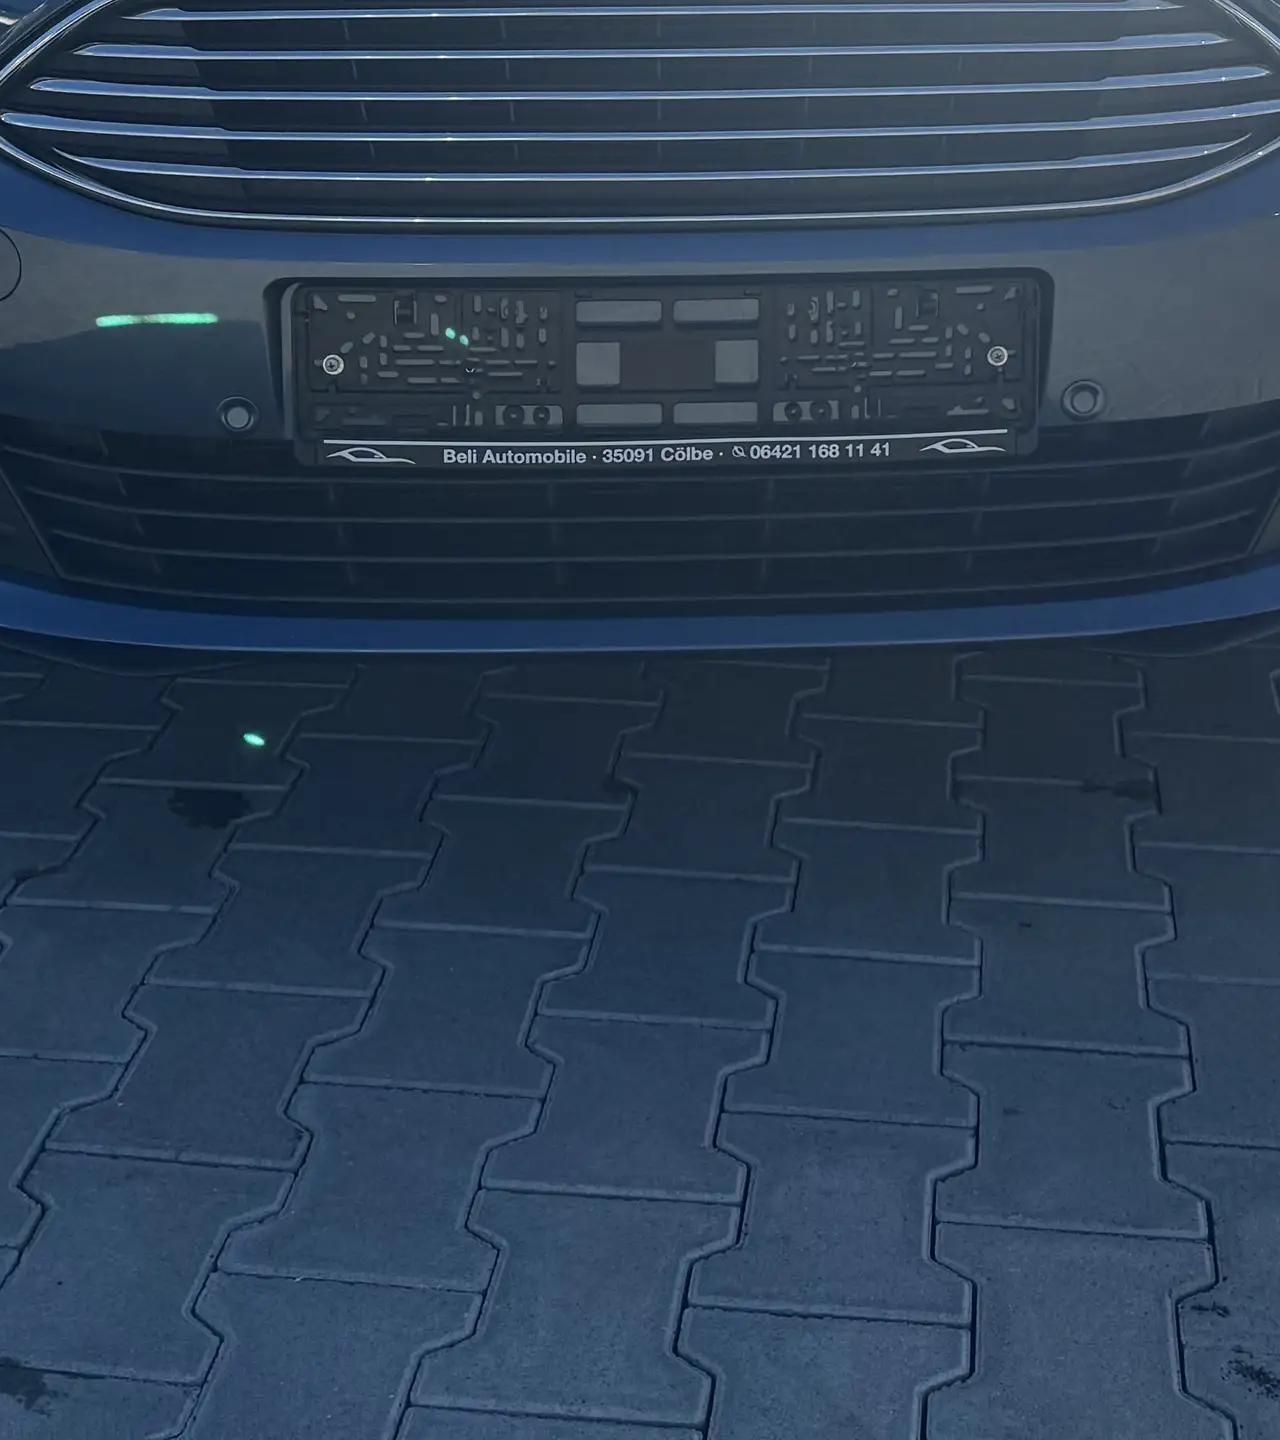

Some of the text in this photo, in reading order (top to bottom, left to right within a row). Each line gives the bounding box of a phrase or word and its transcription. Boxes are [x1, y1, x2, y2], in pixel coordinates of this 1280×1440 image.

[443, 441, 890, 464] Beli Automobile 35091 Cölbe 06421 168 11 41
